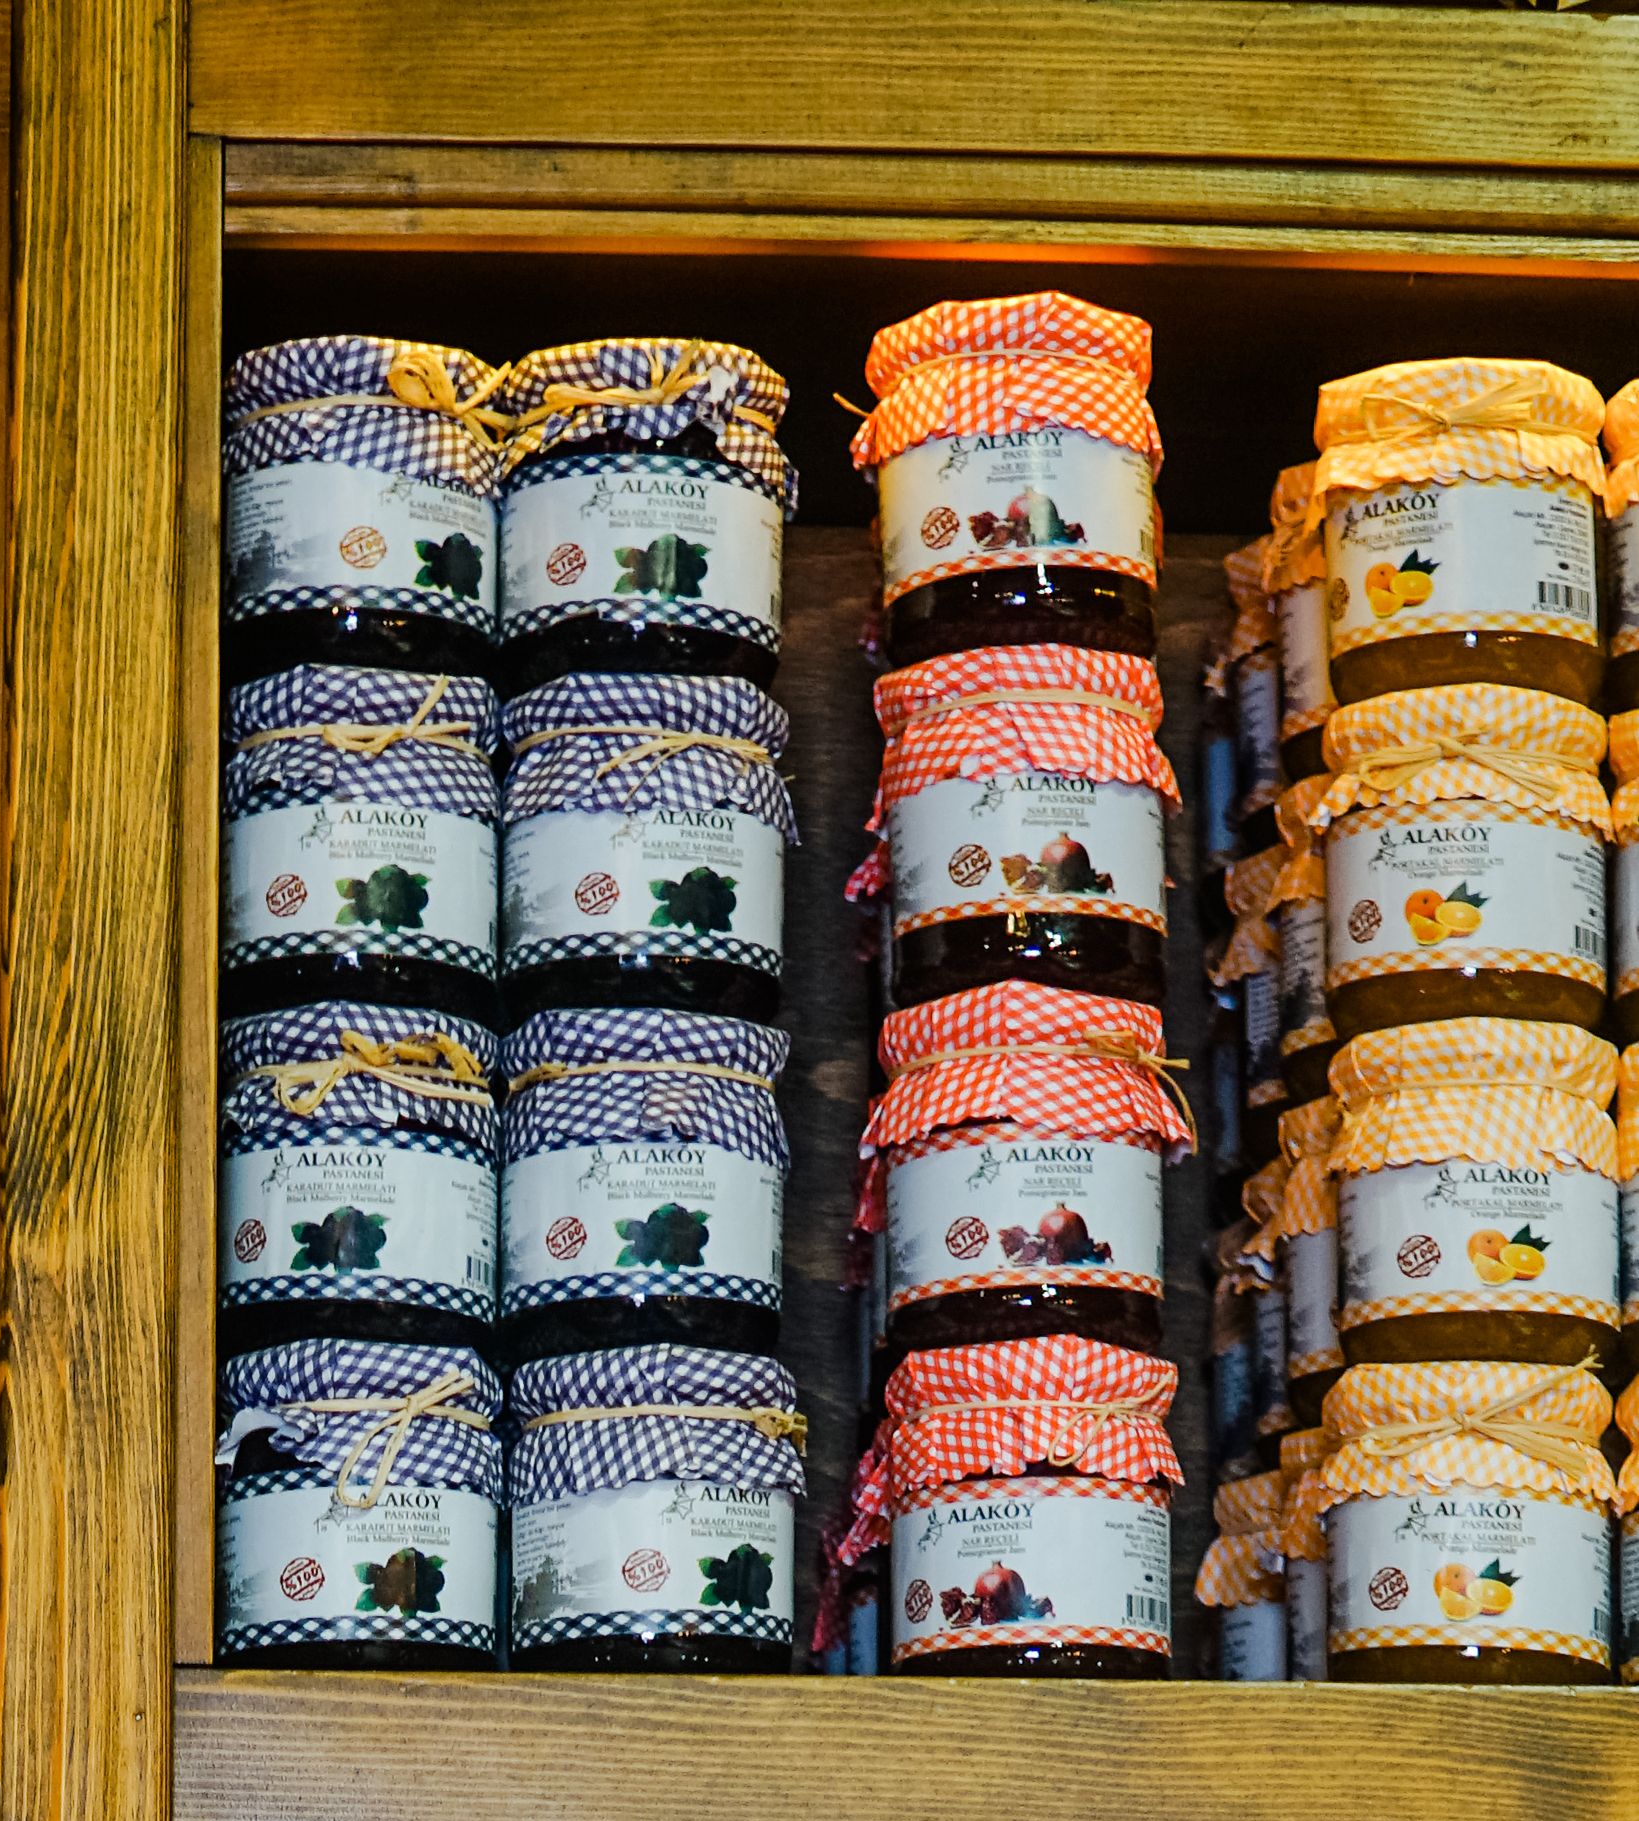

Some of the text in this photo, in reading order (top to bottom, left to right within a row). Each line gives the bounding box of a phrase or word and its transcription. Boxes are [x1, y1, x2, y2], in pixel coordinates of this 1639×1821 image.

[621, 478, 710, 499] ALAKÖY
[1361, 491, 1440, 521] ALAKÖY
[341, 808, 428, 829] ALAKÖY
[1402, 823, 1492, 845] ALAKÖY
[297, 1150, 386, 1168] ALAKÖY
[618, 1147, 707, 1165] ALAKÖY
[1006, 1143, 1095, 1163] ALAKÖY
[947, 1500, 1034, 1524] ALAKÖY
[1435, 1499, 1525, 1520] ALAKÖY
